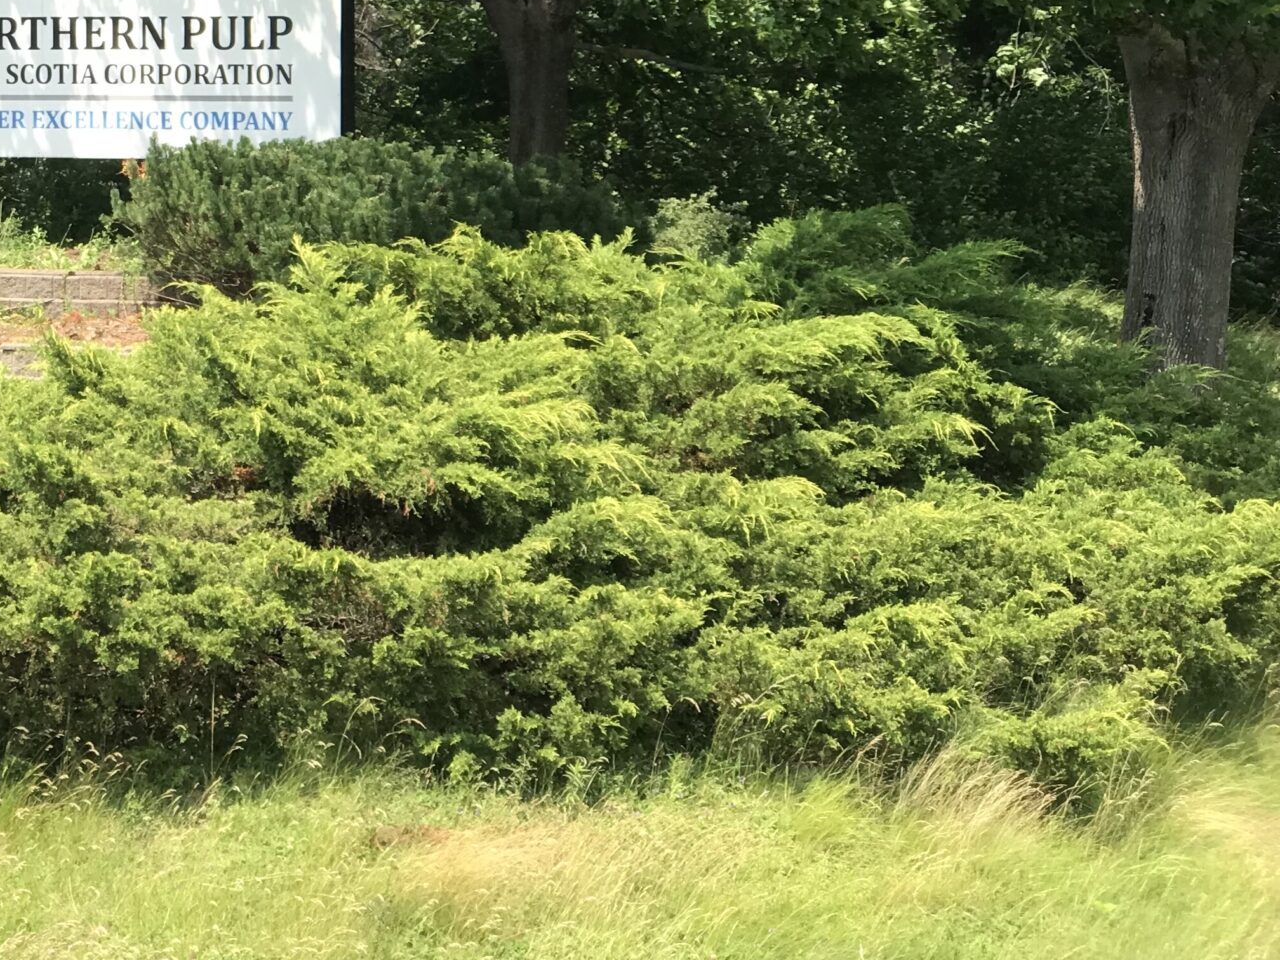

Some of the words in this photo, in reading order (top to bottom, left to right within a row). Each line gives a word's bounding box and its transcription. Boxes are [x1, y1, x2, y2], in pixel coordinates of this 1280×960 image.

[181, 15, 294, 50] PULP
[5, 63, 96, 86] SCOTIA
[103, 63, 294, 86] CORPORATION
[32, 110, 173, 131] EXCELLENCE
[179, 110, 293, 132] COMPANY
